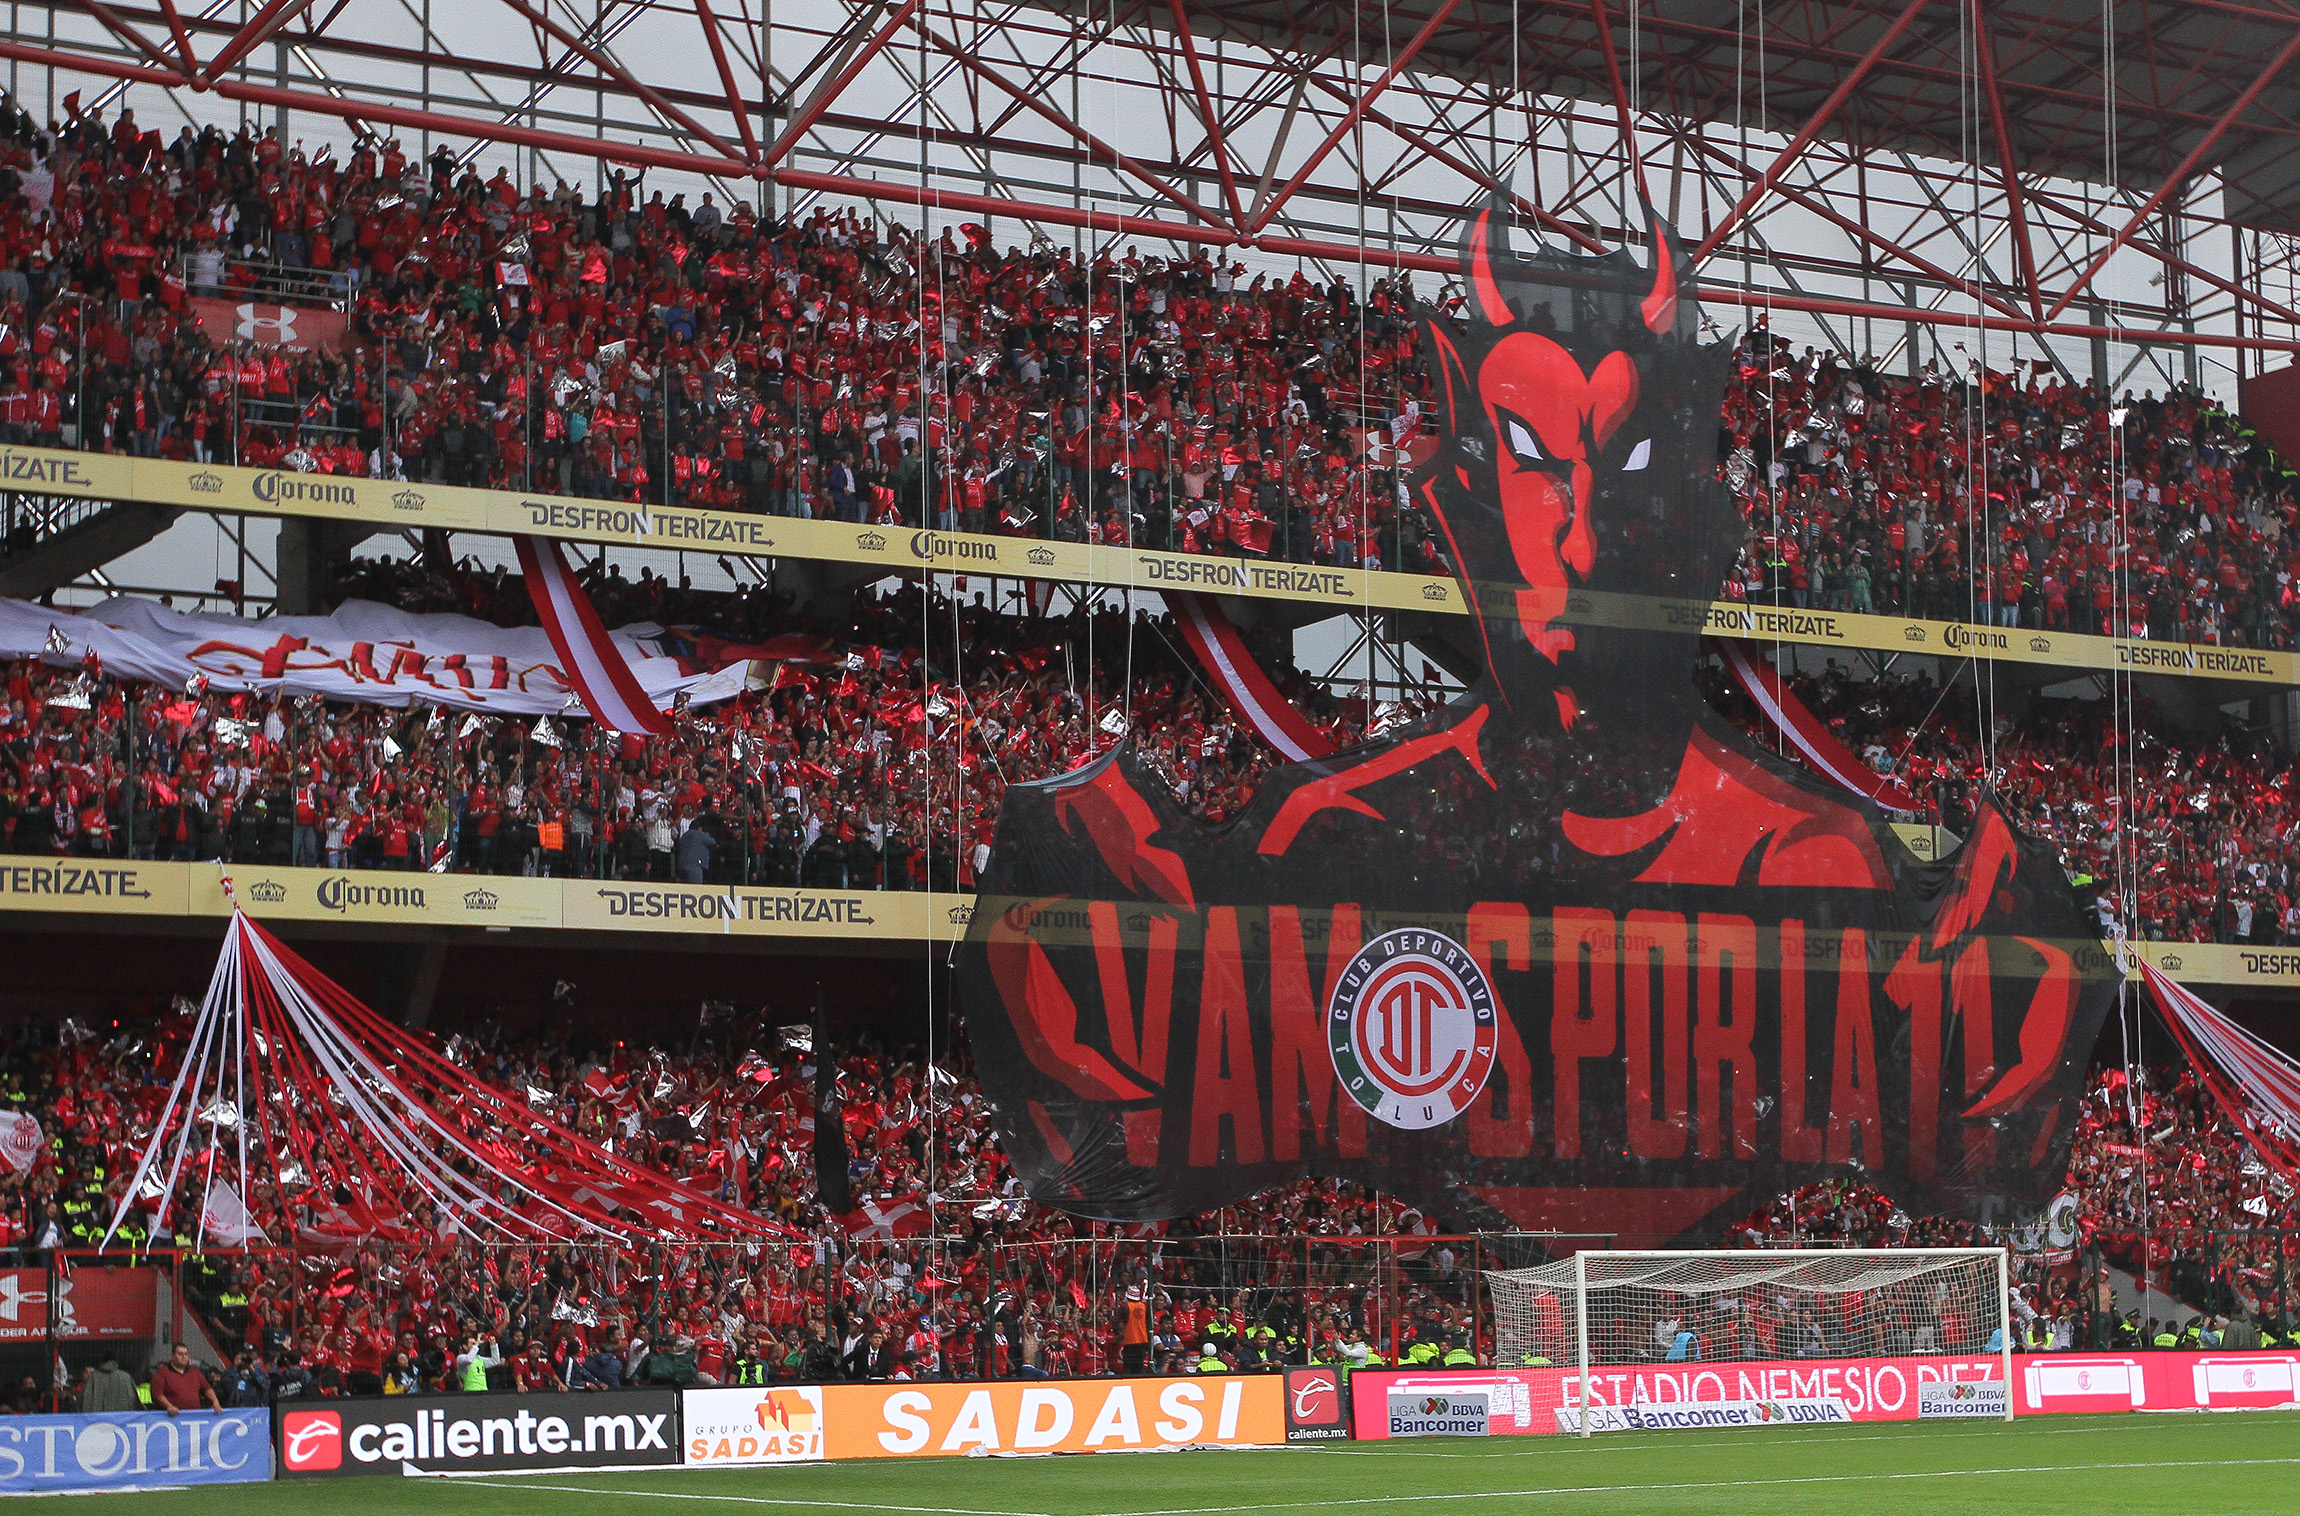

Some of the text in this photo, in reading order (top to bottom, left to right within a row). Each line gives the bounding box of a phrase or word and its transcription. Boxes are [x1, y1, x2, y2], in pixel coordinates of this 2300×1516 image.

[252, 470, 356, 506] Corona
[911, 531, 997, 562] Corona
[1944, 623, 2009, 651] Corona
[317, 876, 426, 913] Corona
[1335, 935, 1491, 1020] CLUB DEPORTIVO
[1551, 905, 1757, 1161] POR
[1780, 917, 1883, 1170] LA
[1883, 934, 1996, 1180] 11
[1336, 1042, 1491, 1121] TOLUCA
[1562, 1371, 1726, 1408] ESTADIO
[1738, 1365, 1906, 1412] NEMESIO
[1921, 1391, 1946, 1400] LIGA
[877, 1381, 1243, 1454] SADASI
[1390, 1404, 1485, 1416] LIGA BBVA
[1390, 1417, 1485, 1433] Bancomer
[1622, 1404, 1749, 1429] Bancomer
[1787, 1403, 1842, 1422] BBVA
[349, 1409, 669, 1464] caliente.mx
[695, 1424, 753, 1436] GRUPO
[1288, 1428, 1347, 1440] caliente.mx
[690, 1434, 819, 1460] SADASI
